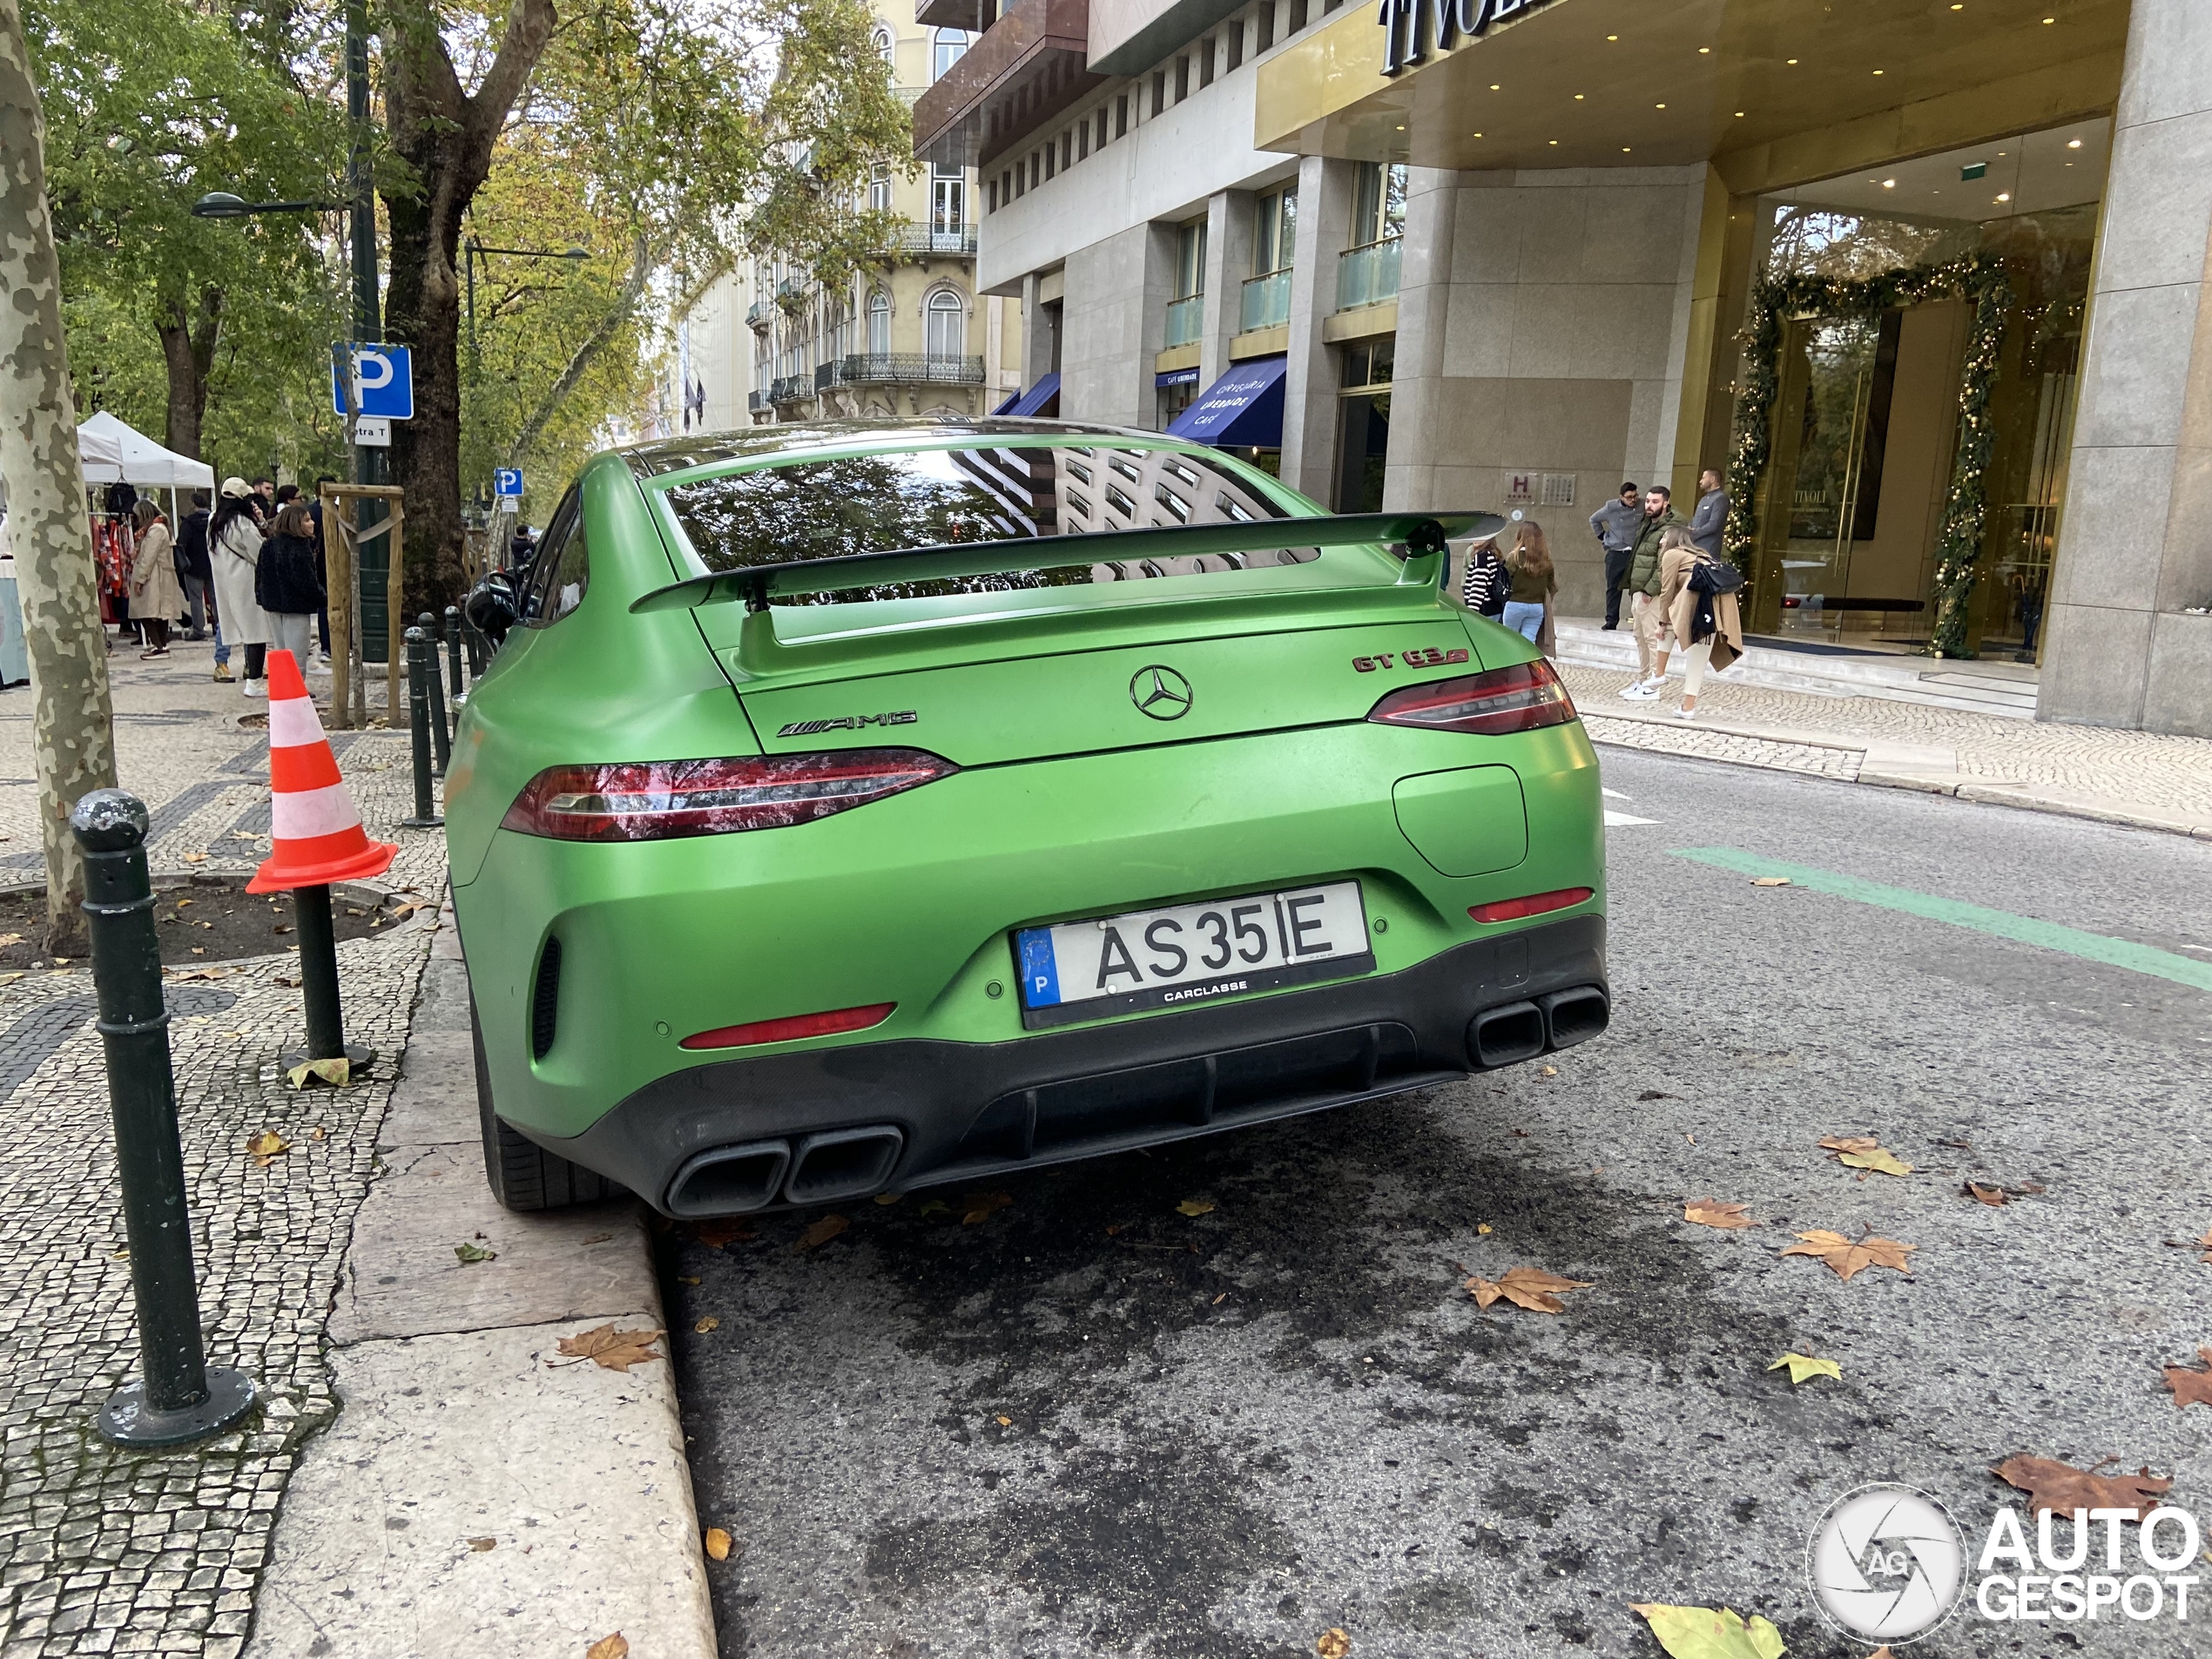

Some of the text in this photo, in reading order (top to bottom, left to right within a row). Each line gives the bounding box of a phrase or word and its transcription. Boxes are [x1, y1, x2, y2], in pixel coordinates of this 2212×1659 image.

[1377, 0, 1534, 77] TIVO
[349, 349, 394, 408] P
[1199, 396, 1249, 410] LIBERDADE
[500, 471, 516, 493] P
[1513, 475, 1528, 493] H
[1794, 489, 1826, 503] TIVOLI
[1352, 653, 1394, 672] GT
[821, 710, 918, 732] AMG
[1035, 975, 1049, 994] P
[1163, 981, 1248, 1002] CARCLASSE
